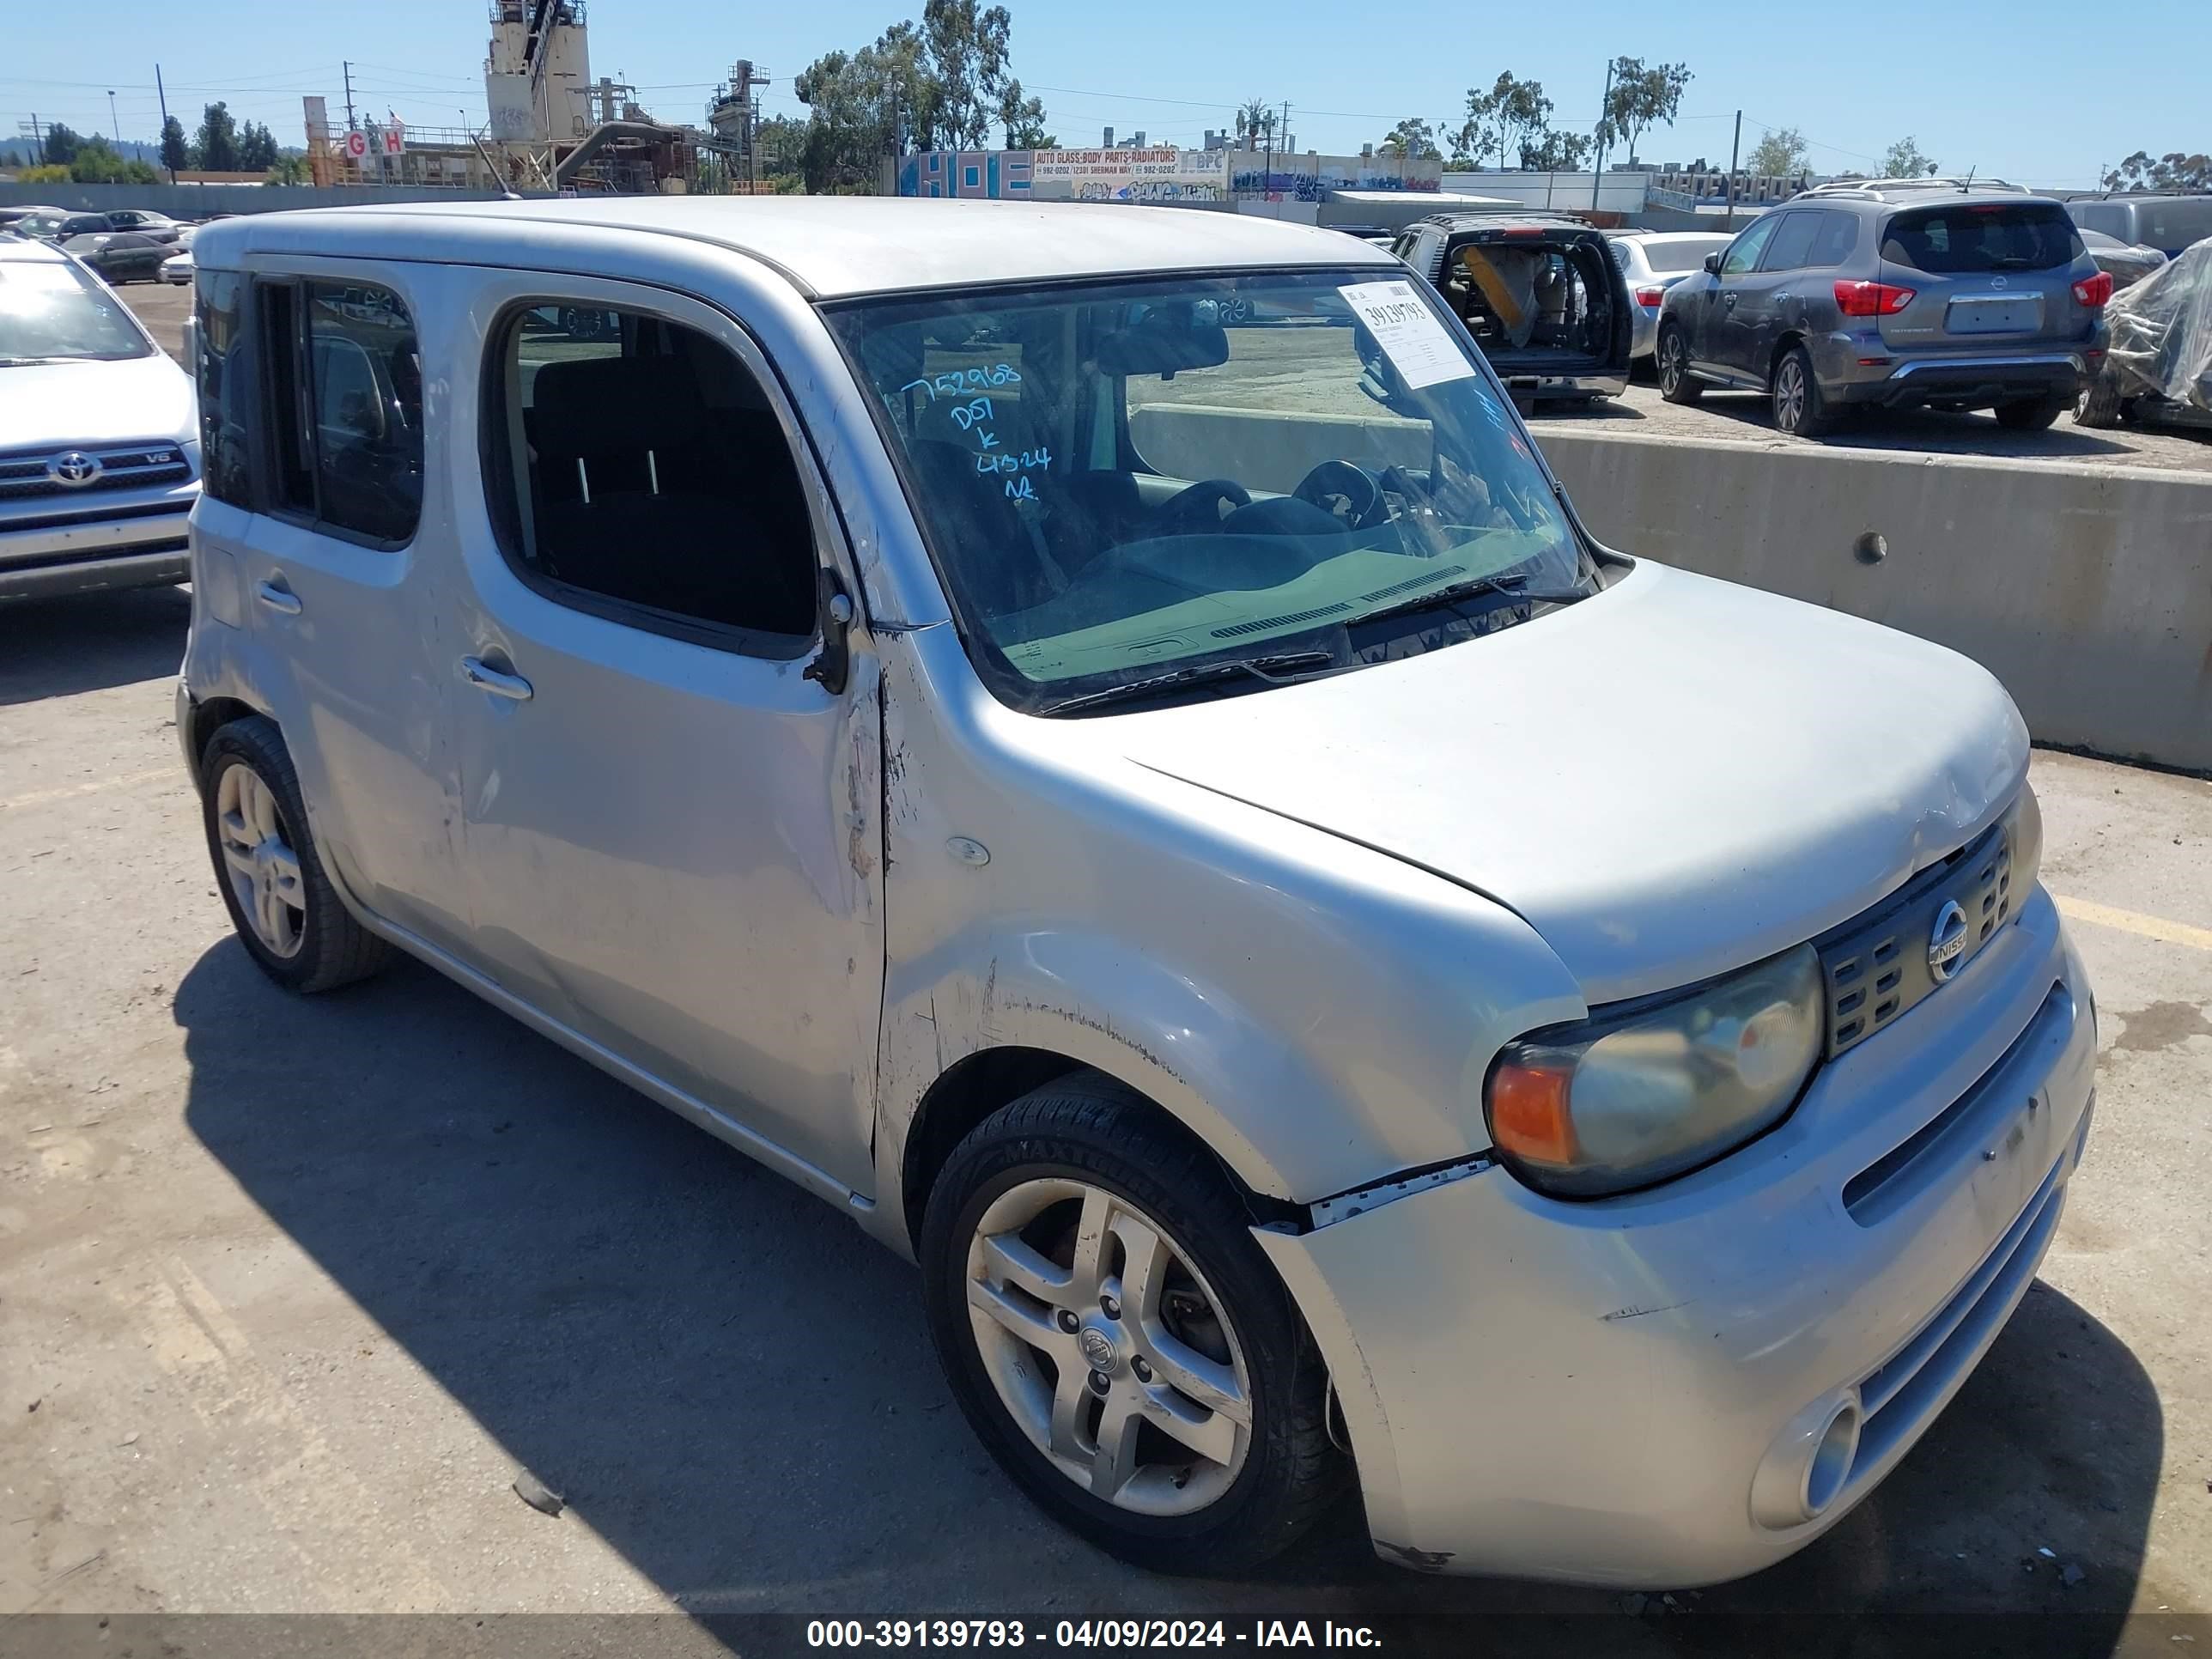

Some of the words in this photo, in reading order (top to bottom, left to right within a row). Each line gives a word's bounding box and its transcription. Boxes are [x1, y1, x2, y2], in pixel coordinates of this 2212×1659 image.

[349, 132, 366, 155] G
[386, 131, 402, 153] H
[1036, 152, 1054, 164] AUTO
[1365, 301, 1426, 326] 39139793
